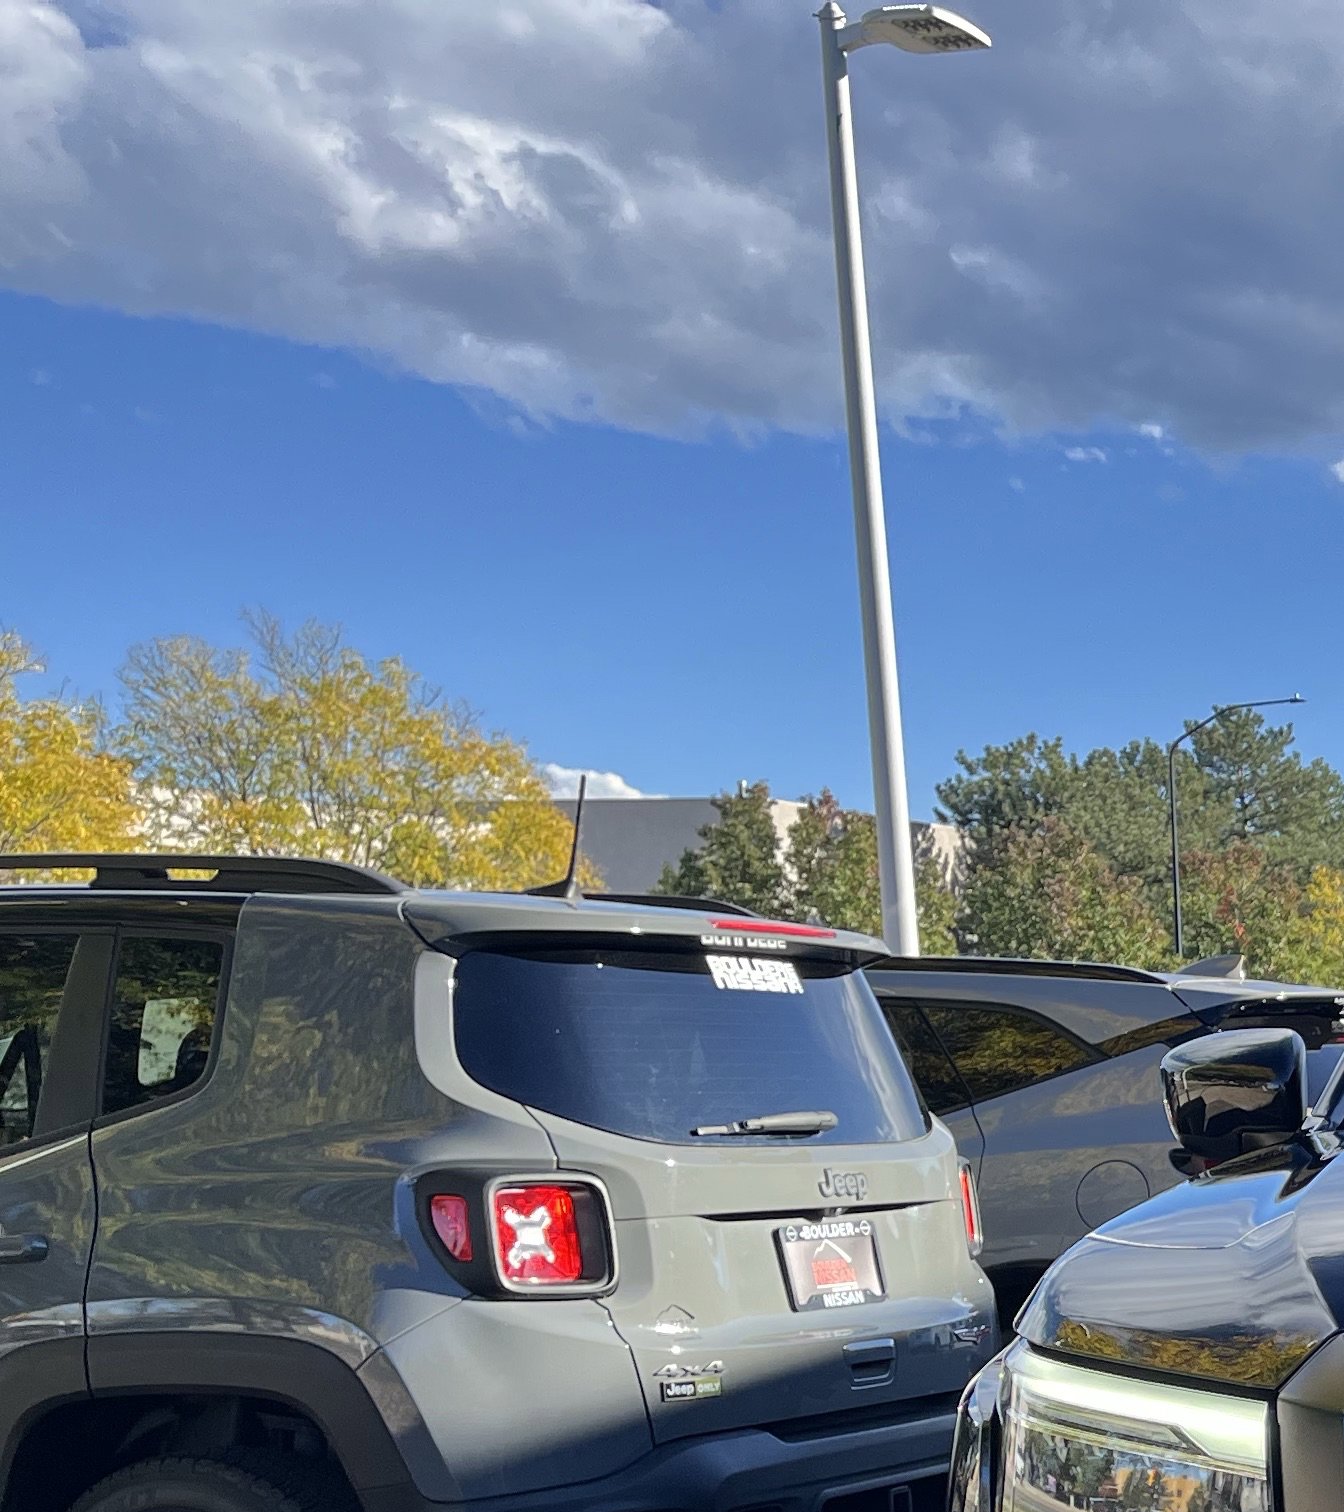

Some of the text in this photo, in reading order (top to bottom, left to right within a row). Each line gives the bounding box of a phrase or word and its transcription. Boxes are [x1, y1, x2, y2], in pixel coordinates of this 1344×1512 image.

[818, 1168, 867, 1201] Jeep
[802, 1222, 854, 1240] BOULDER
[823, 1290, 865, 1307] NISSAN
